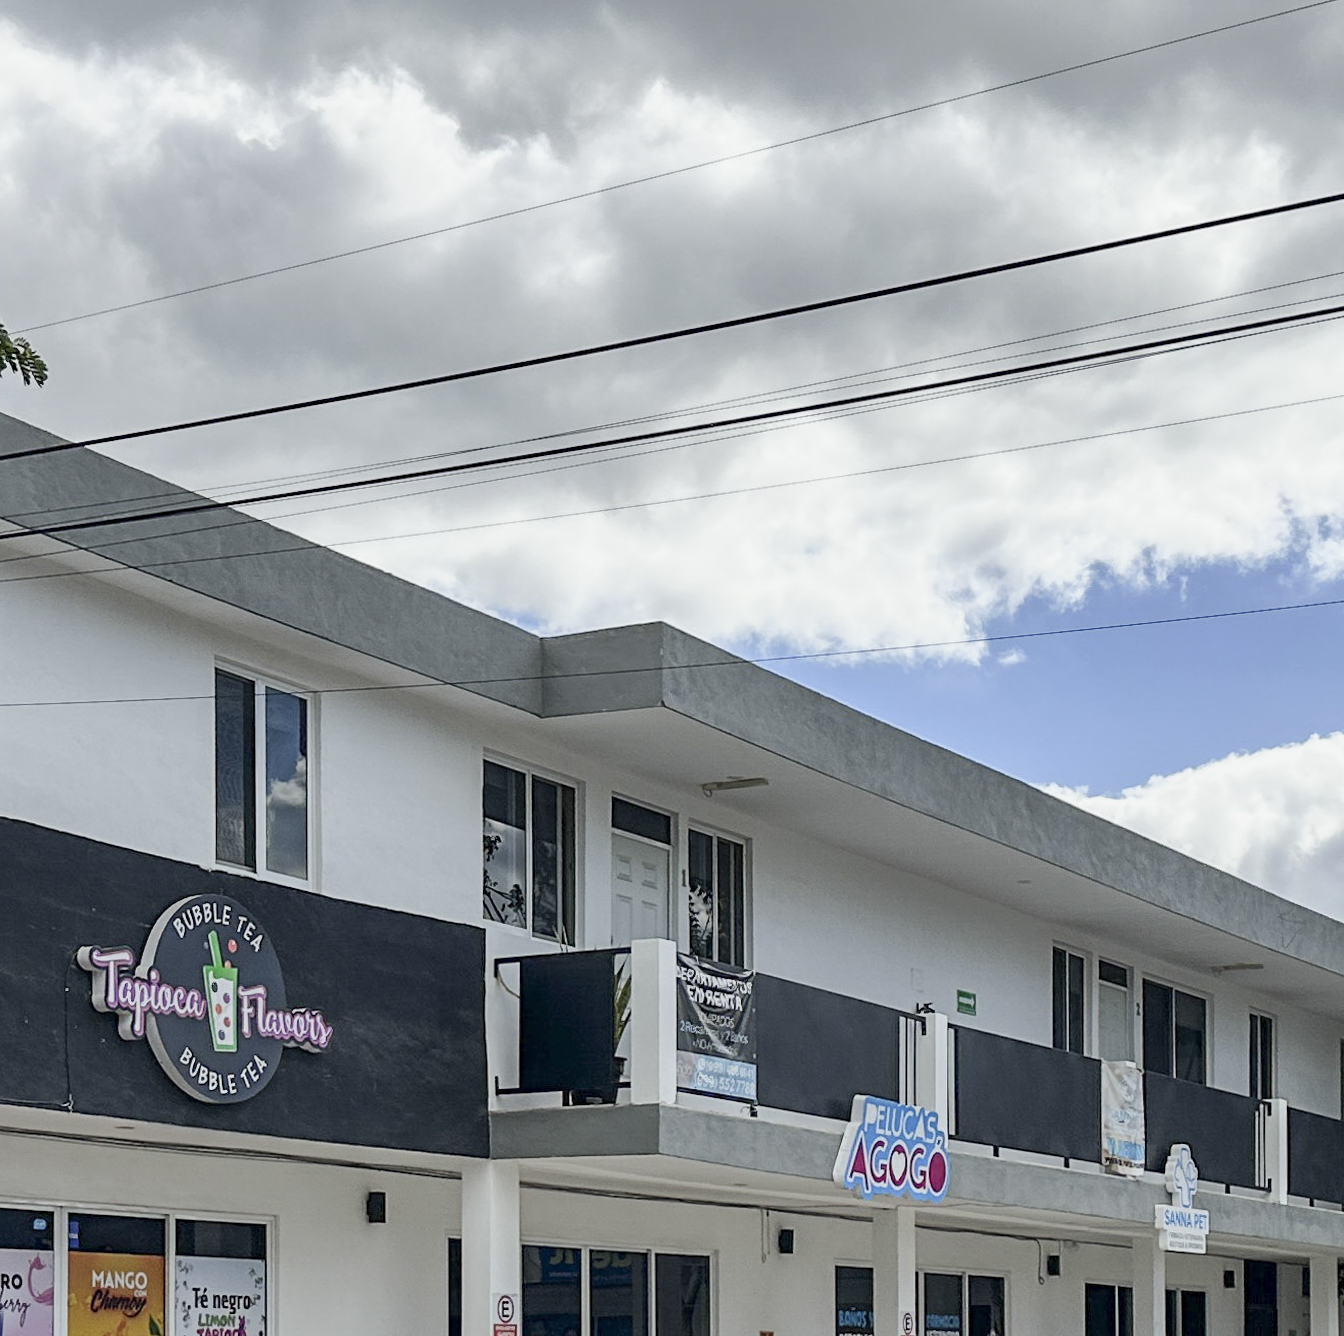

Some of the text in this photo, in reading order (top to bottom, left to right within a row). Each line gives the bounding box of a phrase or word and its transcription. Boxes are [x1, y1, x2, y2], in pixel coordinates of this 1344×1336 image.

[173, 902, 264, 952] BUBBLE TEA
[93, 951, 333, 1047] Tapioca Flavors
[686, 984, 743, 1011] EN RENTA
[179, 1047, 268, 1094] BUBBLE TEA
[864, 1103, 936, 1143] PELUCAS
[1165, 1209, 1193, 1228] SANNA
[92, 1270, 147, 1289] MANGO
[90, 1289, 147, 1318] Chamoy
[192, 1287, 251, 1314] Té negro
[502, 1301, 509, 1317] E
